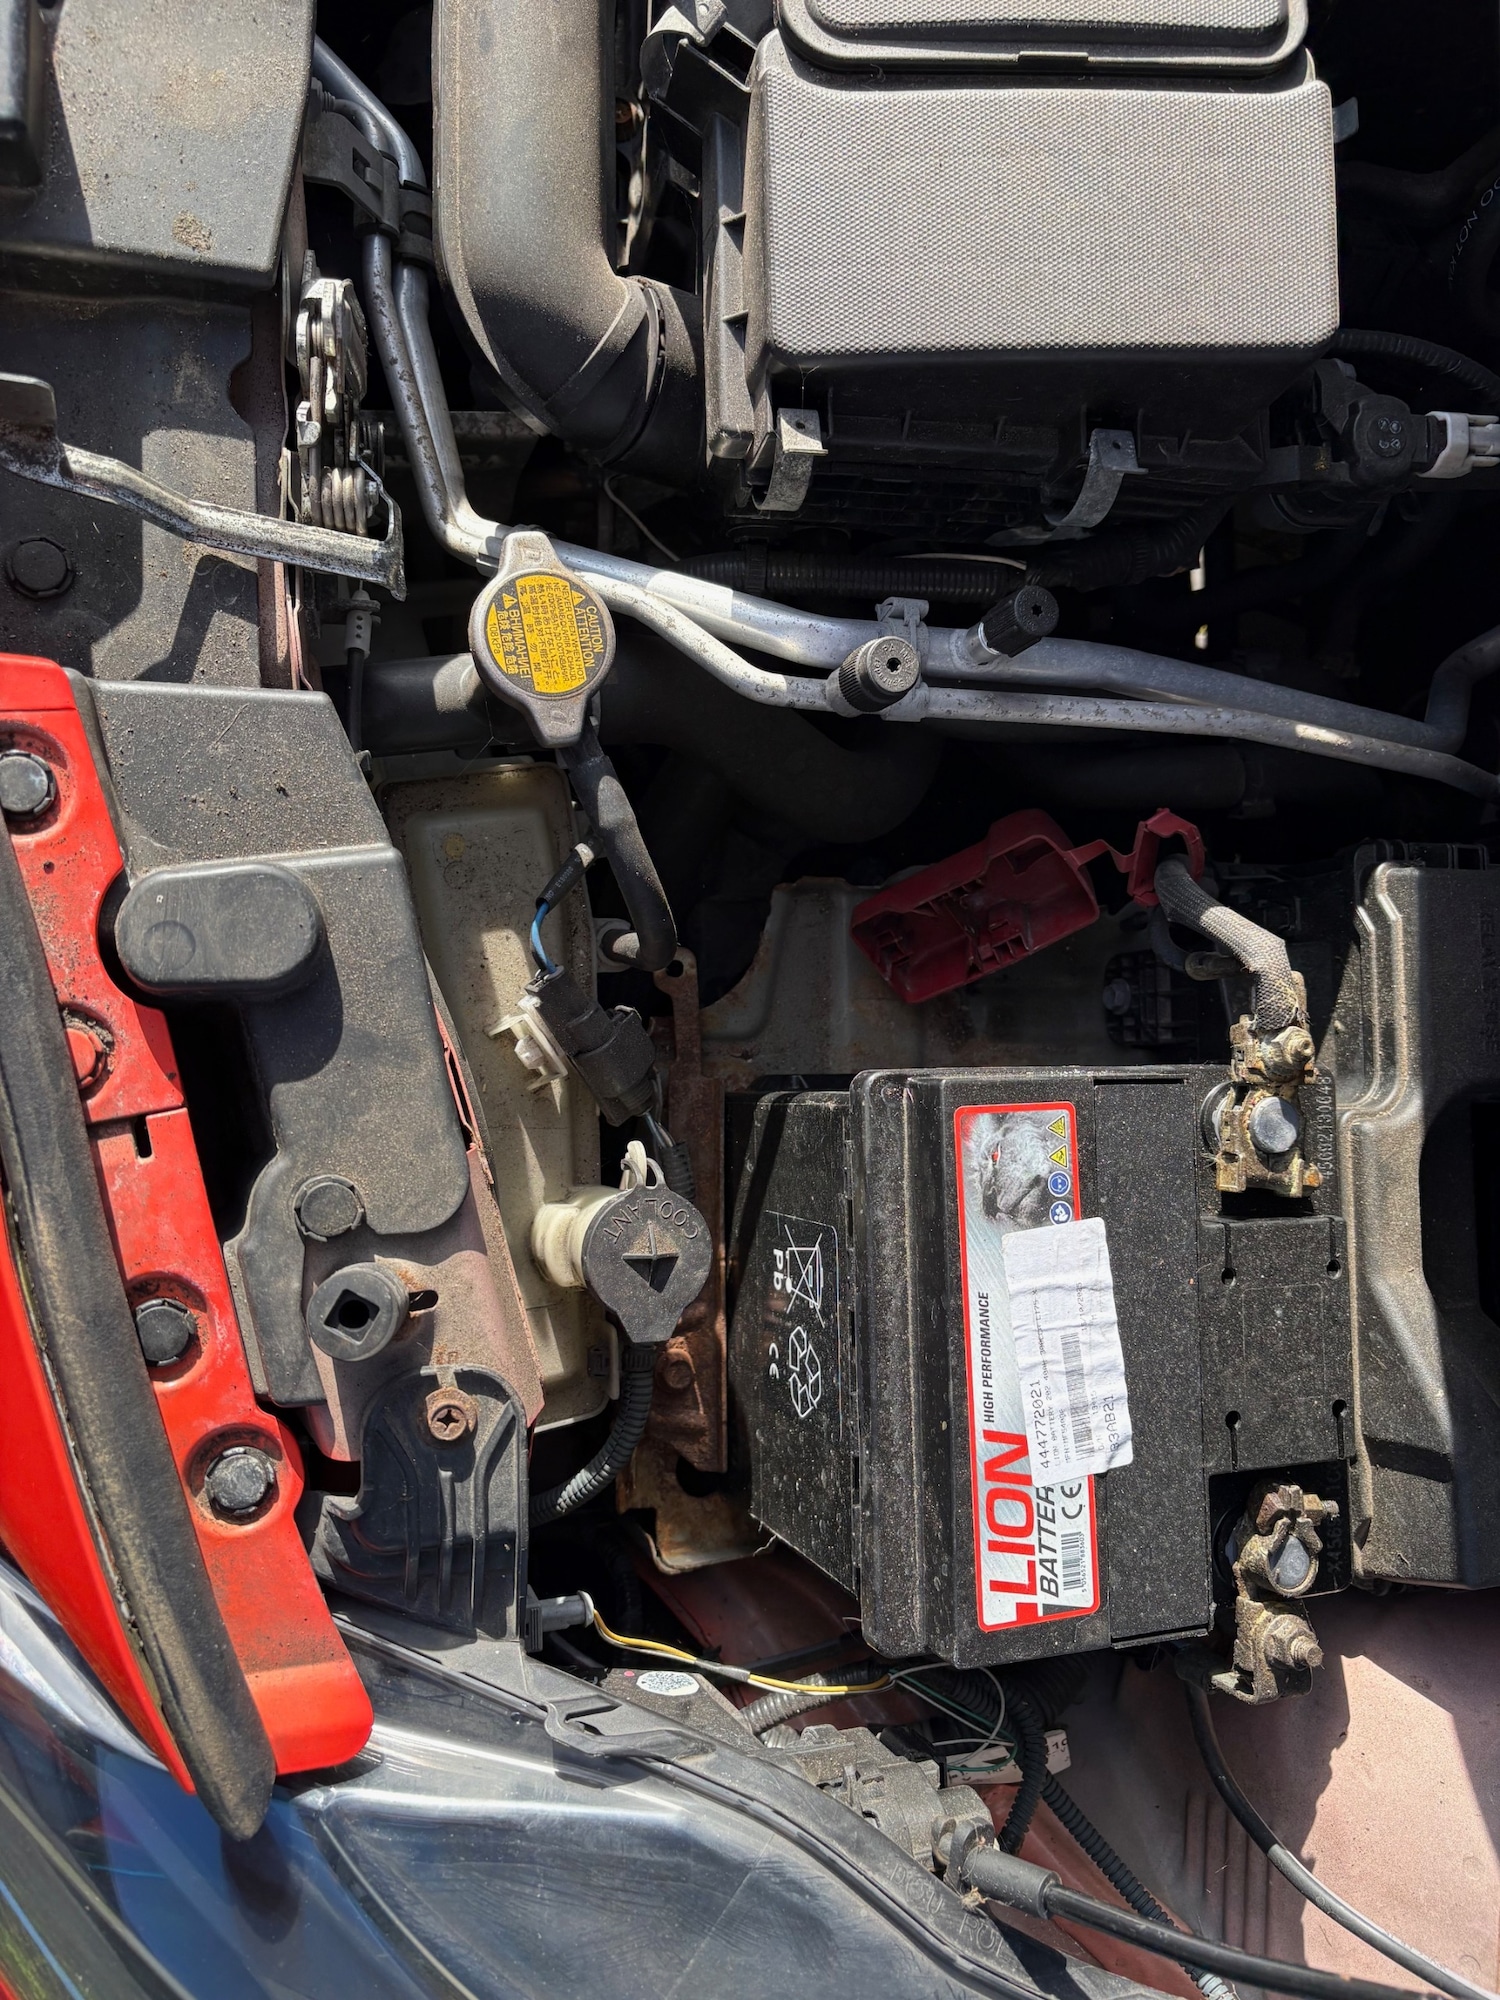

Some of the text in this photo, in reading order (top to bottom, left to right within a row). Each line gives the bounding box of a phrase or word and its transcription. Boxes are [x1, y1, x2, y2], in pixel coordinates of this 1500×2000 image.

[562, 584, 573, 613] NEVER
[509, 609, 532, 679] ВНИМАНИЕ!
[567, 613, 578, 638] OPEN
[575, 606, 596, 668] ATTENTION
[586, 605, 605, 653] CAUTION
[571, 638, 582, 663] WHEN
[604, 1201, 699, 1243] COOLANT
[773, 1248, 784, 1289] Pb
[980, 1292, 995, 1423] HIGH PERFORMANCE
[1029, 1379, 1050, 1469] 444772021
[1051, 1445, 1060, 1466] LION
[983, 1430, 1037, 1597] LION
[1036, 1485, 1060, 1597] BATTER
